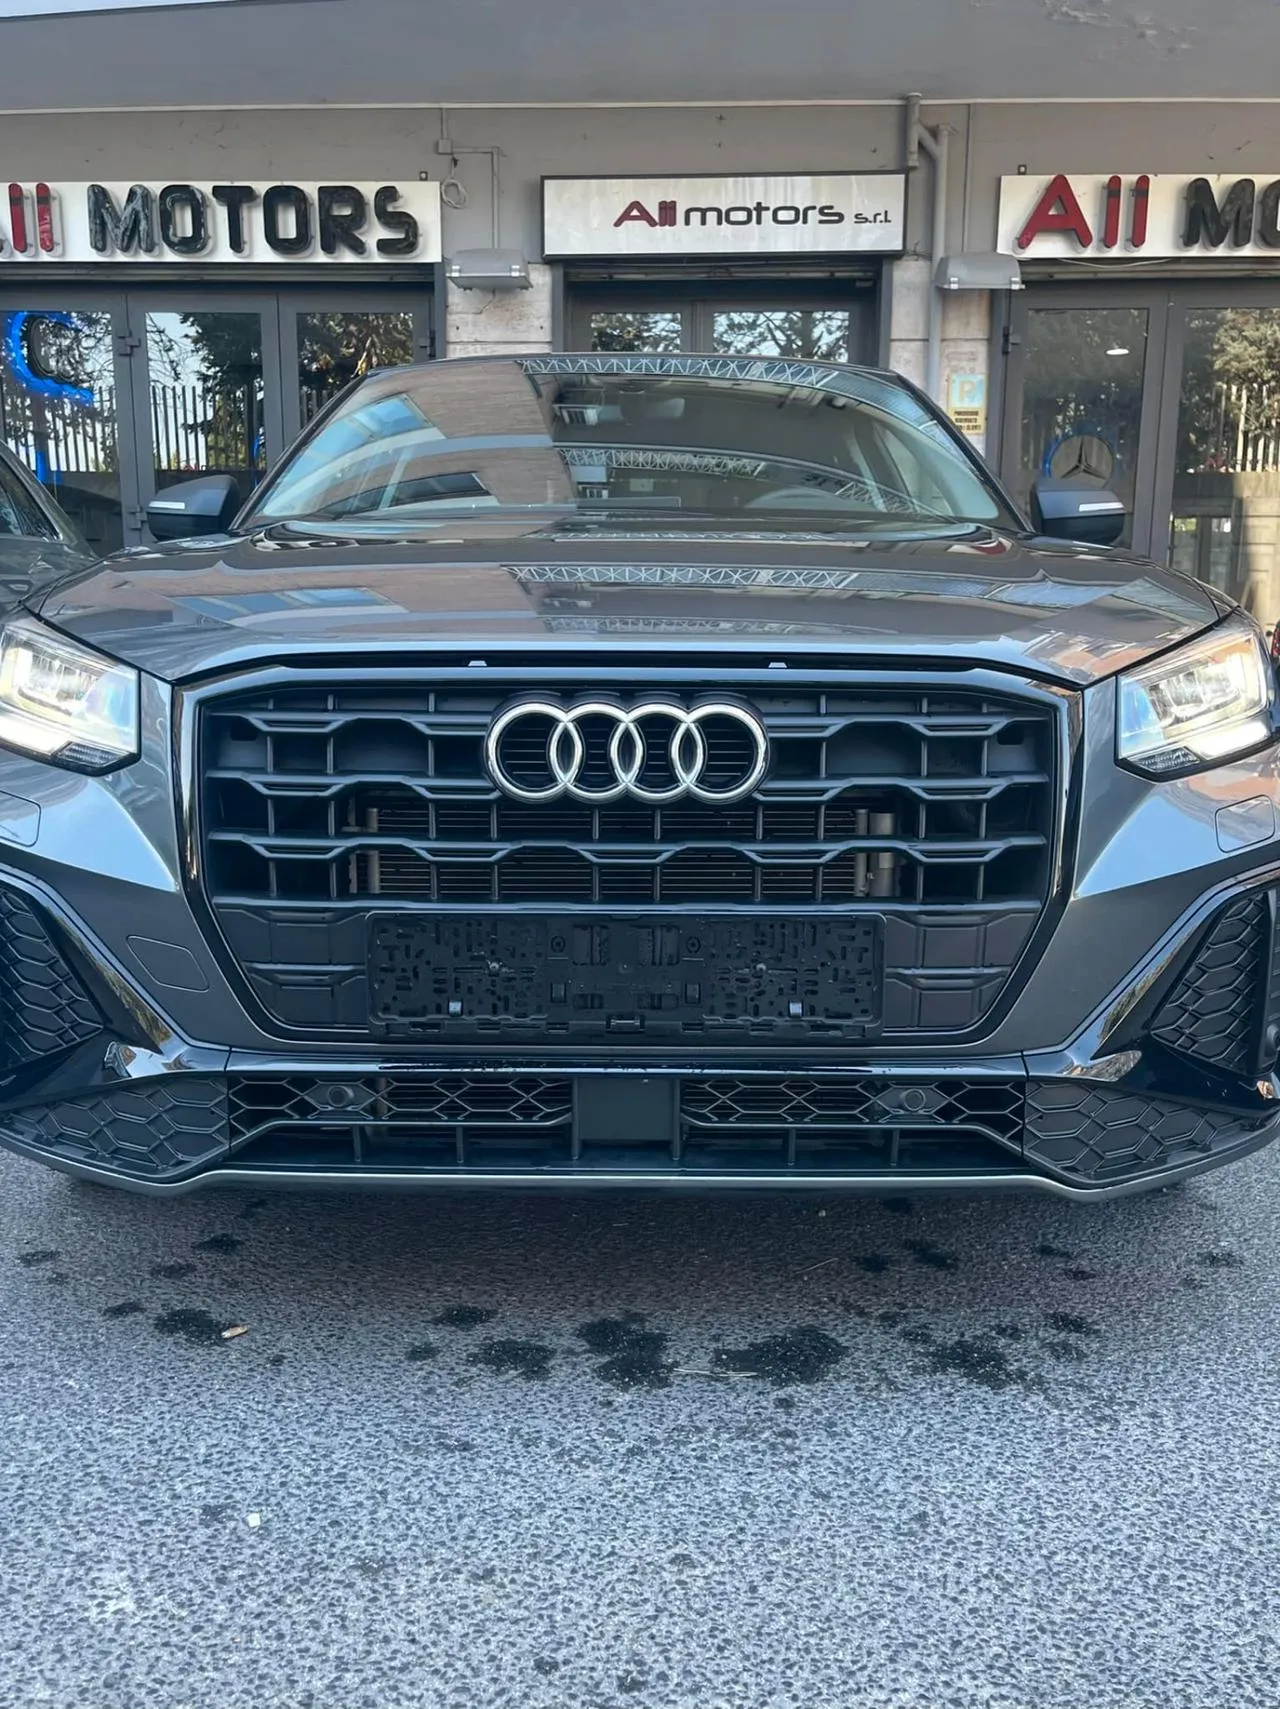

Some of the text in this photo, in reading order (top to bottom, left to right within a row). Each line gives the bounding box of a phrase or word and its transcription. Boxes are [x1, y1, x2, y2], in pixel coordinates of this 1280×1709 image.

[0, 183, 420, 254] ll MOTORS
[613, 200, 677, 228] All
[684, 201, 845, 226] motors
[1018, 174, 1149, 249] All
[959, 380, 976, 402] P
